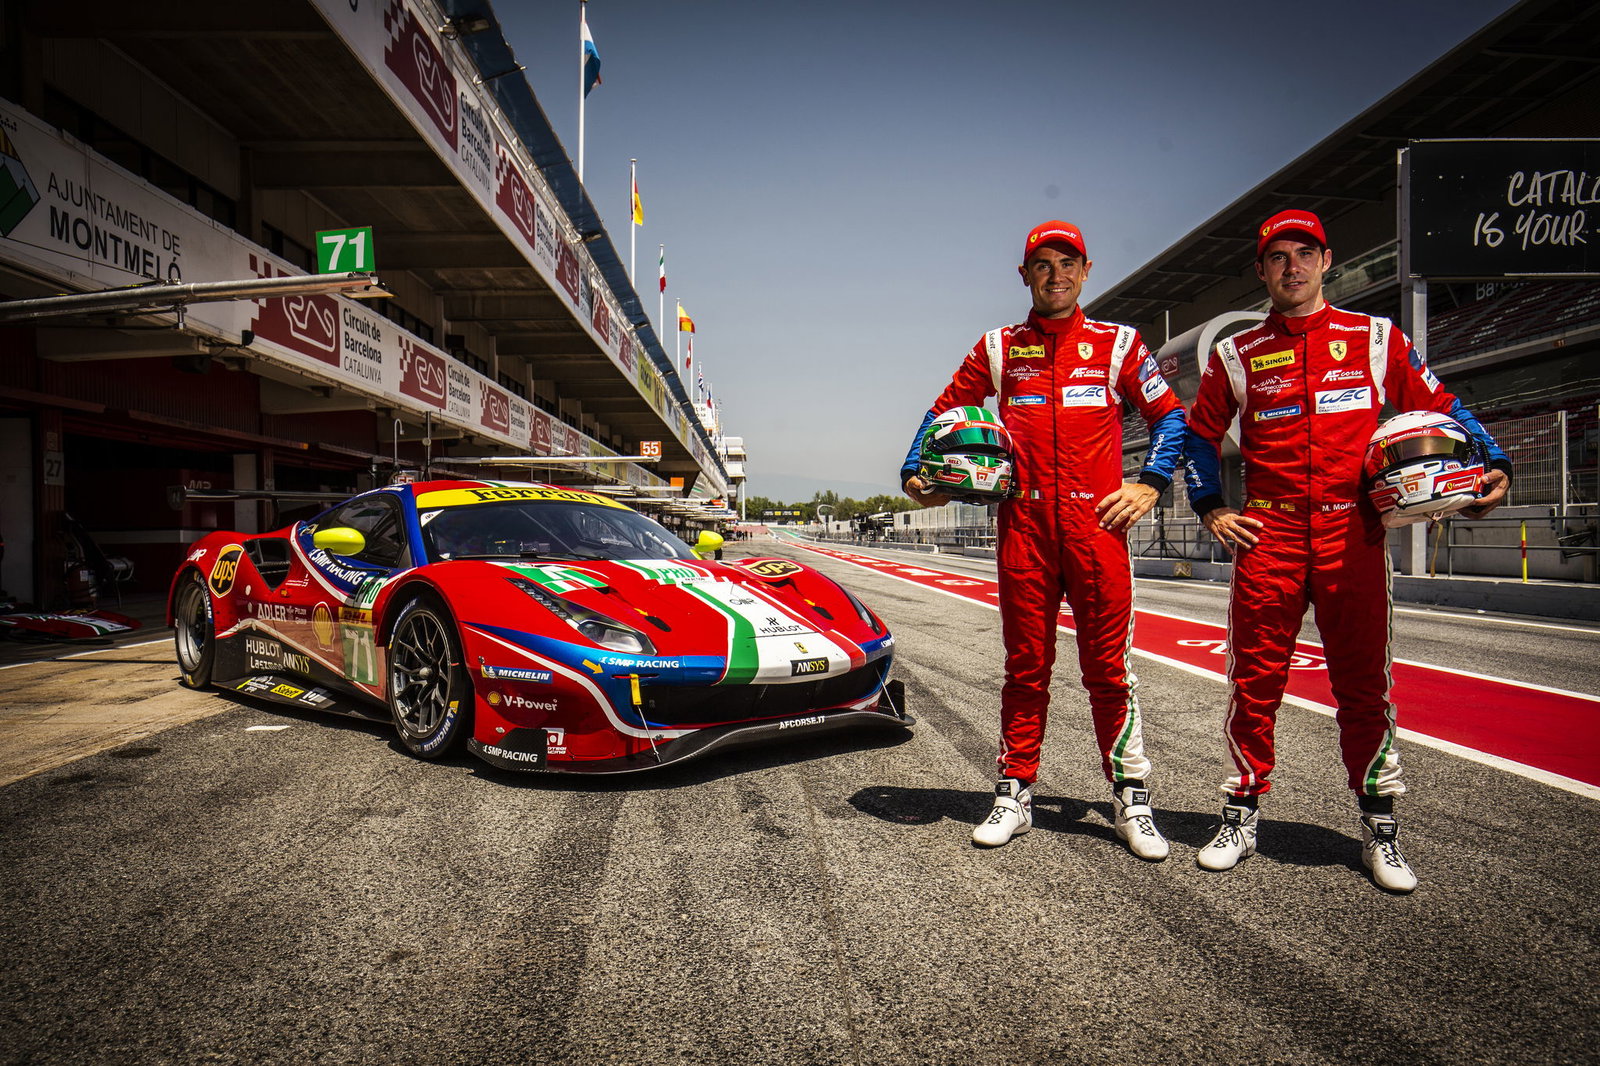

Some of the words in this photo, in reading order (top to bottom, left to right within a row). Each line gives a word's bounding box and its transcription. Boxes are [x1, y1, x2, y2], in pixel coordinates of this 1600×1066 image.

[462, 116, 490, 172] Barcelona
[48, 172, 158, 244] AJUNTAMENT
[162, 230, 181, 256] DE
[1473, 212, 1504, 248] IS
[1515, 209, 1587, 251] YOUR
[50, 205, 181, 284] MONTMELÓ
[322, 231, 366, 271] 71
[343, 307, 371, 338] Circuit
[371, 323, 381, 343] de
[1118, 331, 1130, 351] Sabelt
[1375, 322, 1384, 346] Sabelt
[344, 331, 382, 364] Barcelona
[1265, 355, 1293, 366] SINGHA
[343, 356, 382, 384] CATALUNYA
[1321, 369, 1342, 382] AF
[1065, 387, 1104, 398] WEC
[1318, 389, 1367, 404] WEC
[1267, 408, 1297, 418] MICHELIN
[642, 442, 659, 455] 55
[46, 459, 62, 478] 27
[1447, 463, 1460, 471] BELL
[466, 488, 607, 504] Ferrari
[1070, 491, 1078, 499] D.
[1079, 492, 1095, 500] Rigo
[1322, 504, 1332, 512] M.
[213, 561, 236, 589] ups
[658, 568, 694, 579] PRO
[751, 561, 796, 575] ups
[257, 602, 286, 622] ADLER
[759, 624, 803, 634] HUBLOT
[245, 639, 281, 658] HUBLOT
[344, 628, 373, 682] 71
[283, 652, 311, 674] ANSYS
[607, 657, 636, 666] SMP
[636, 659, 679, 669] RACING
[796, 659, 826, 673] ANSYS
[498, 669, 550, 680] MICHELIN
[503, 694, 558, 711] V-Power
[779, 715, 826, 730] AFCORSE.IT
[487, 745, 503, 756] SMP
[502, 749, 538, 763] RACING
